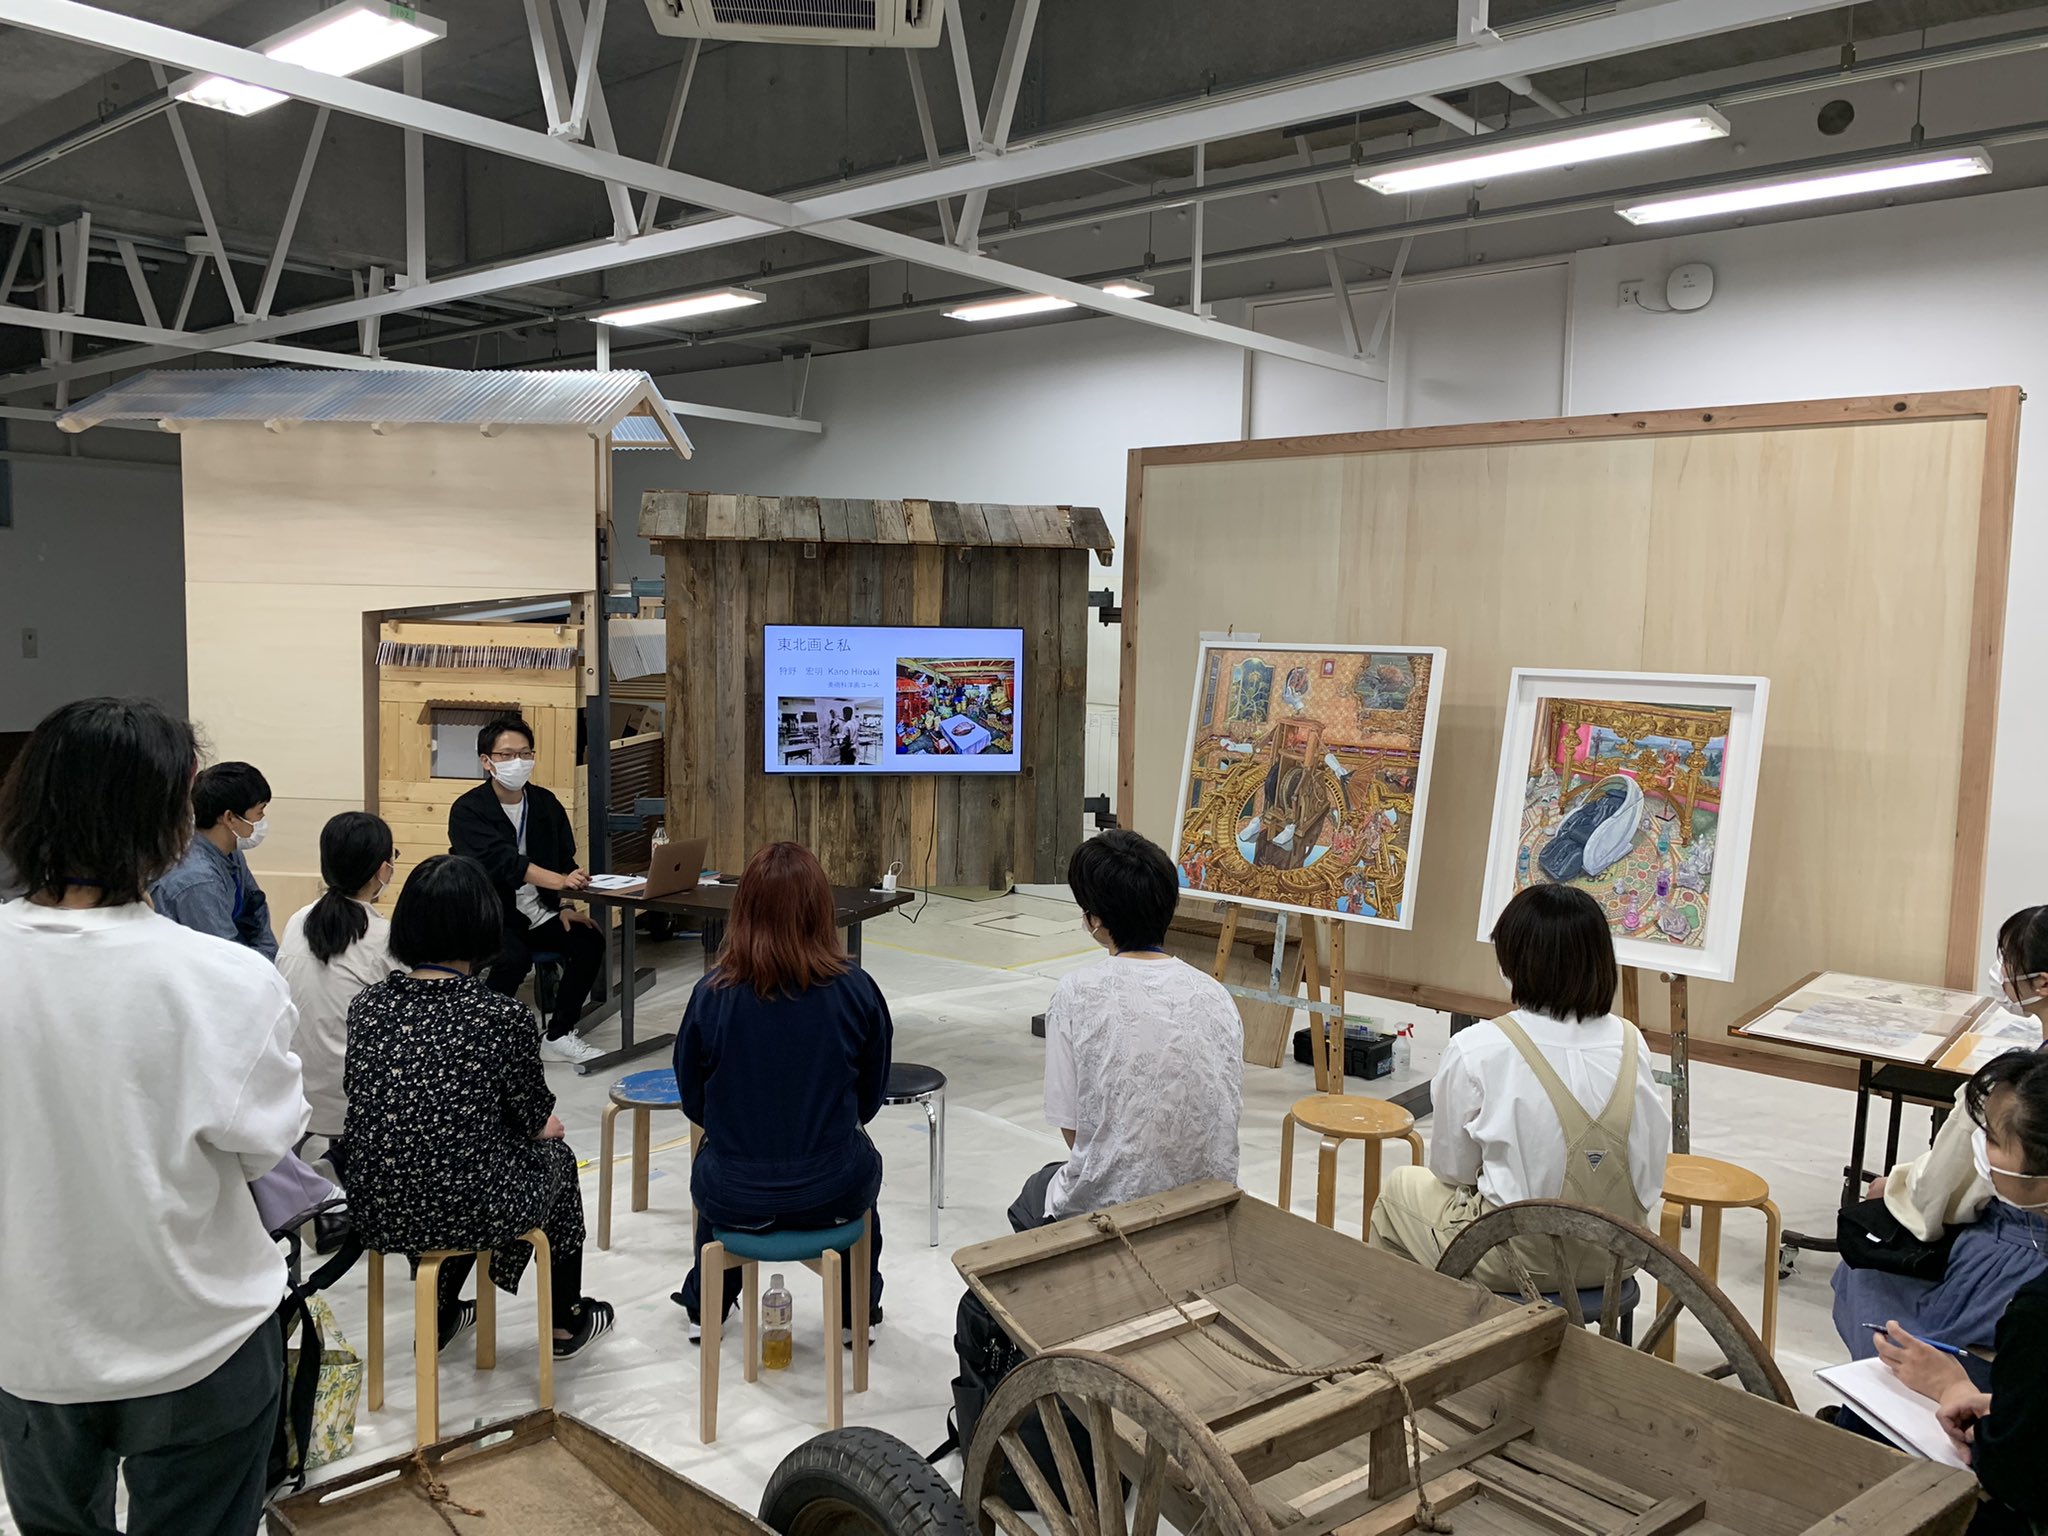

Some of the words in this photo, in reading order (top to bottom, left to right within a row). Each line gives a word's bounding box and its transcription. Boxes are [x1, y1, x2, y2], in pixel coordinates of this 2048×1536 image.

[777, 637, 851, 652] 東北画と私
[779, 667, 796, 676] 狩野
[828, 667, 848, 676] Kano
[851, 667, 880, 676] Hiroaki
